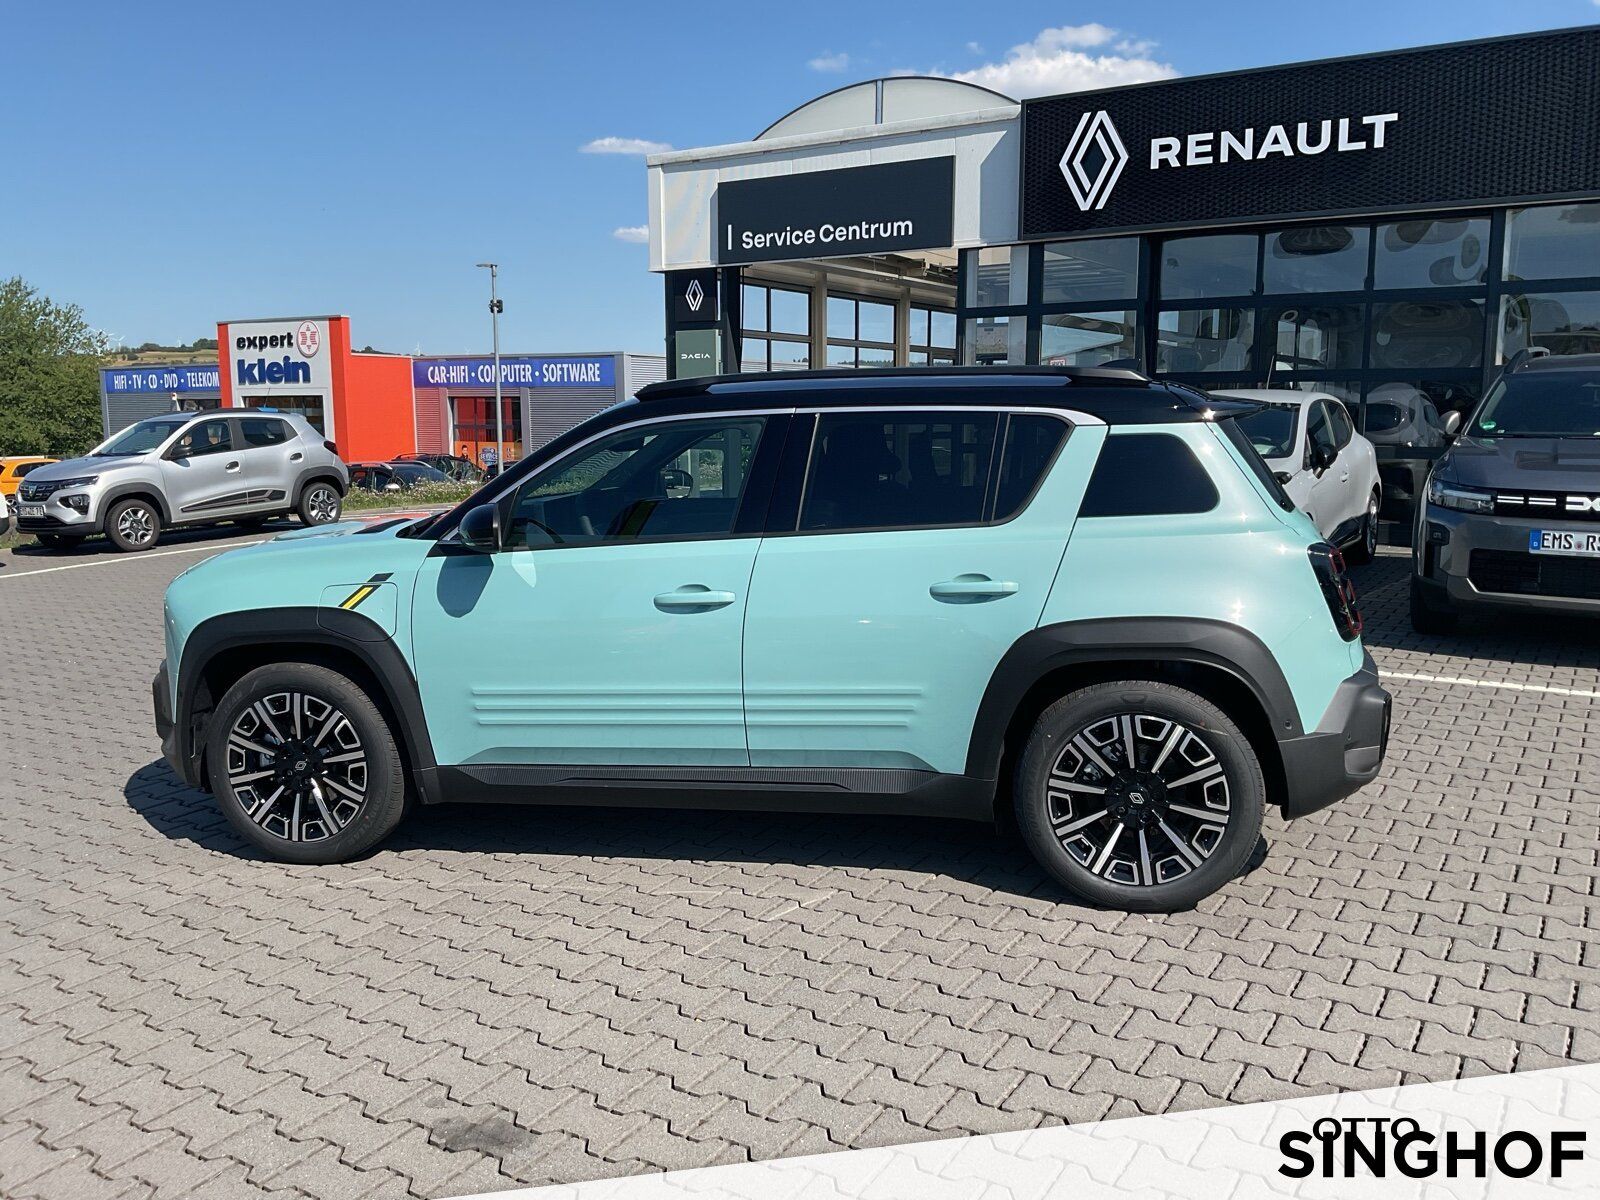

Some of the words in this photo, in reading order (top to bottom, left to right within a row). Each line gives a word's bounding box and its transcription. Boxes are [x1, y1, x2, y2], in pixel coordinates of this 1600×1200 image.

[1150, 112, 1399, 170] RENAULT
[741, 226, 816, 250] Service
[819, 220, 913, 243] Centrum
[236, 332, 294, 351] expert
[114, 374, 128, 390] HIFI
[132, 374, 142, 389] TV
[148, 374, 158, 389] CD
[164, 373, 178, 389] DVD
[187, 371, 220, 388] TELEKOM
[237, 355, 311, 386] klein
[427, 365, 469, 384] CAR-HIFI
[543, 363, 600, 383] SOFTWARE
[1541, 532, 1573, 550] EMS
[1585, 535, 1600, 552] R
